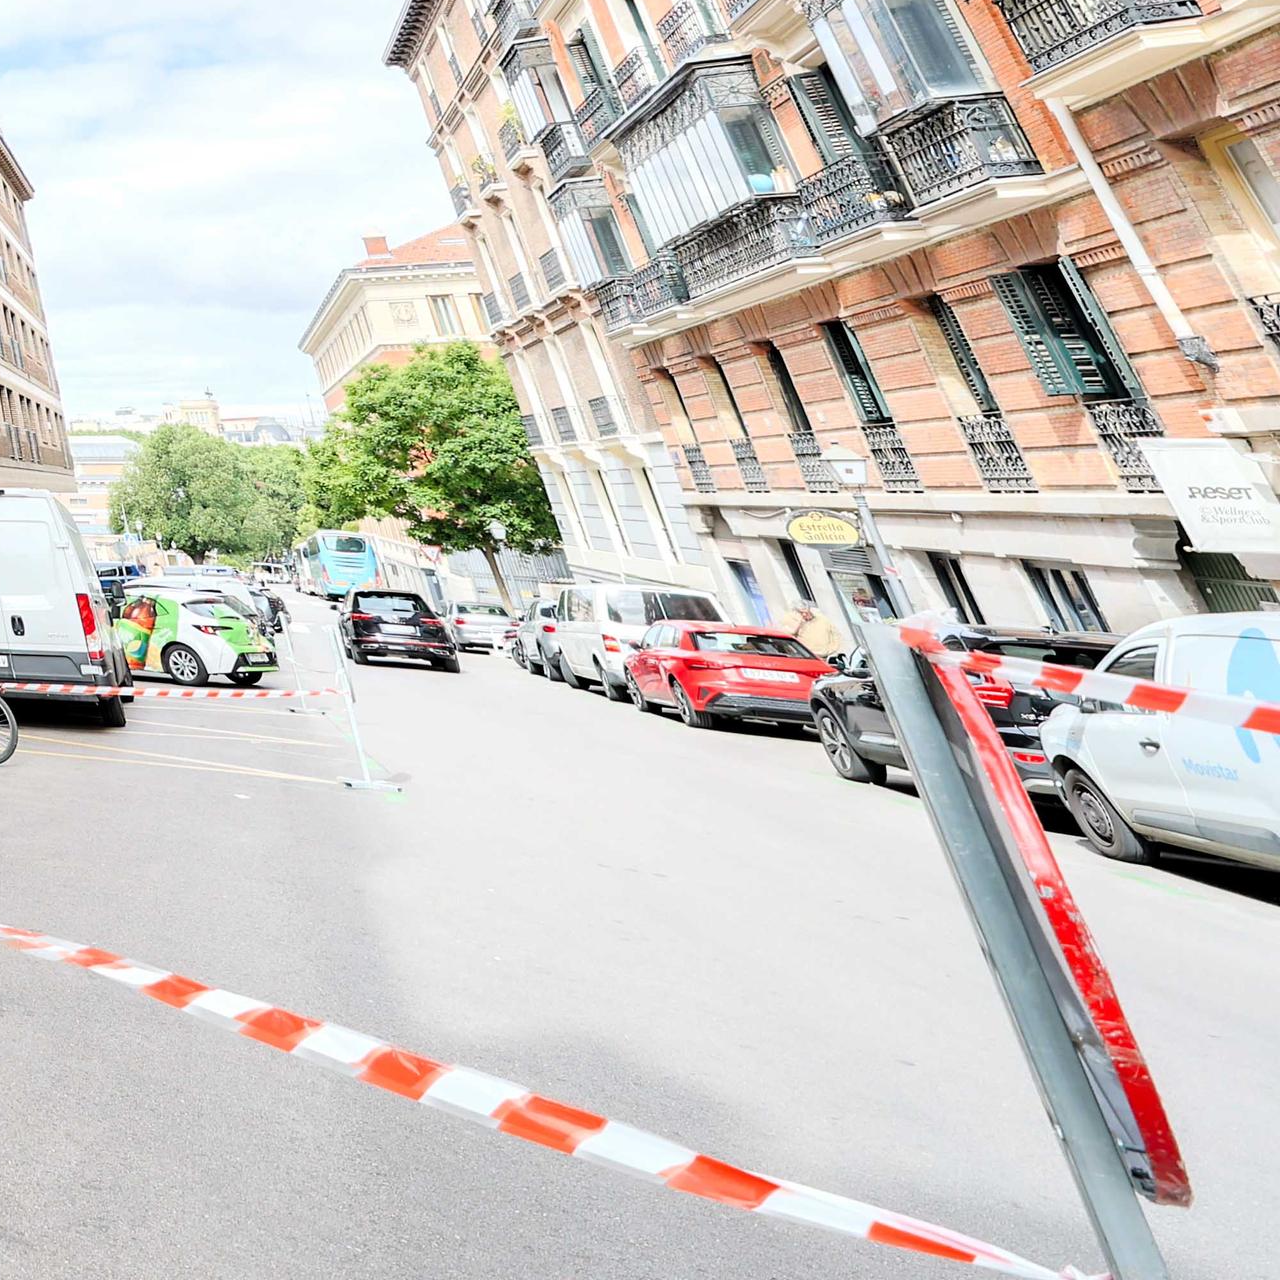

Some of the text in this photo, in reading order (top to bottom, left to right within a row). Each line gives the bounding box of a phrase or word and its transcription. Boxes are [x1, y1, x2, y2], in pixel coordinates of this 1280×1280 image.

[799, 522, 844, 532] Estrella
[805, 531, 846, 541] Galicia
[1181, 756, 1240, 781] Movistar
